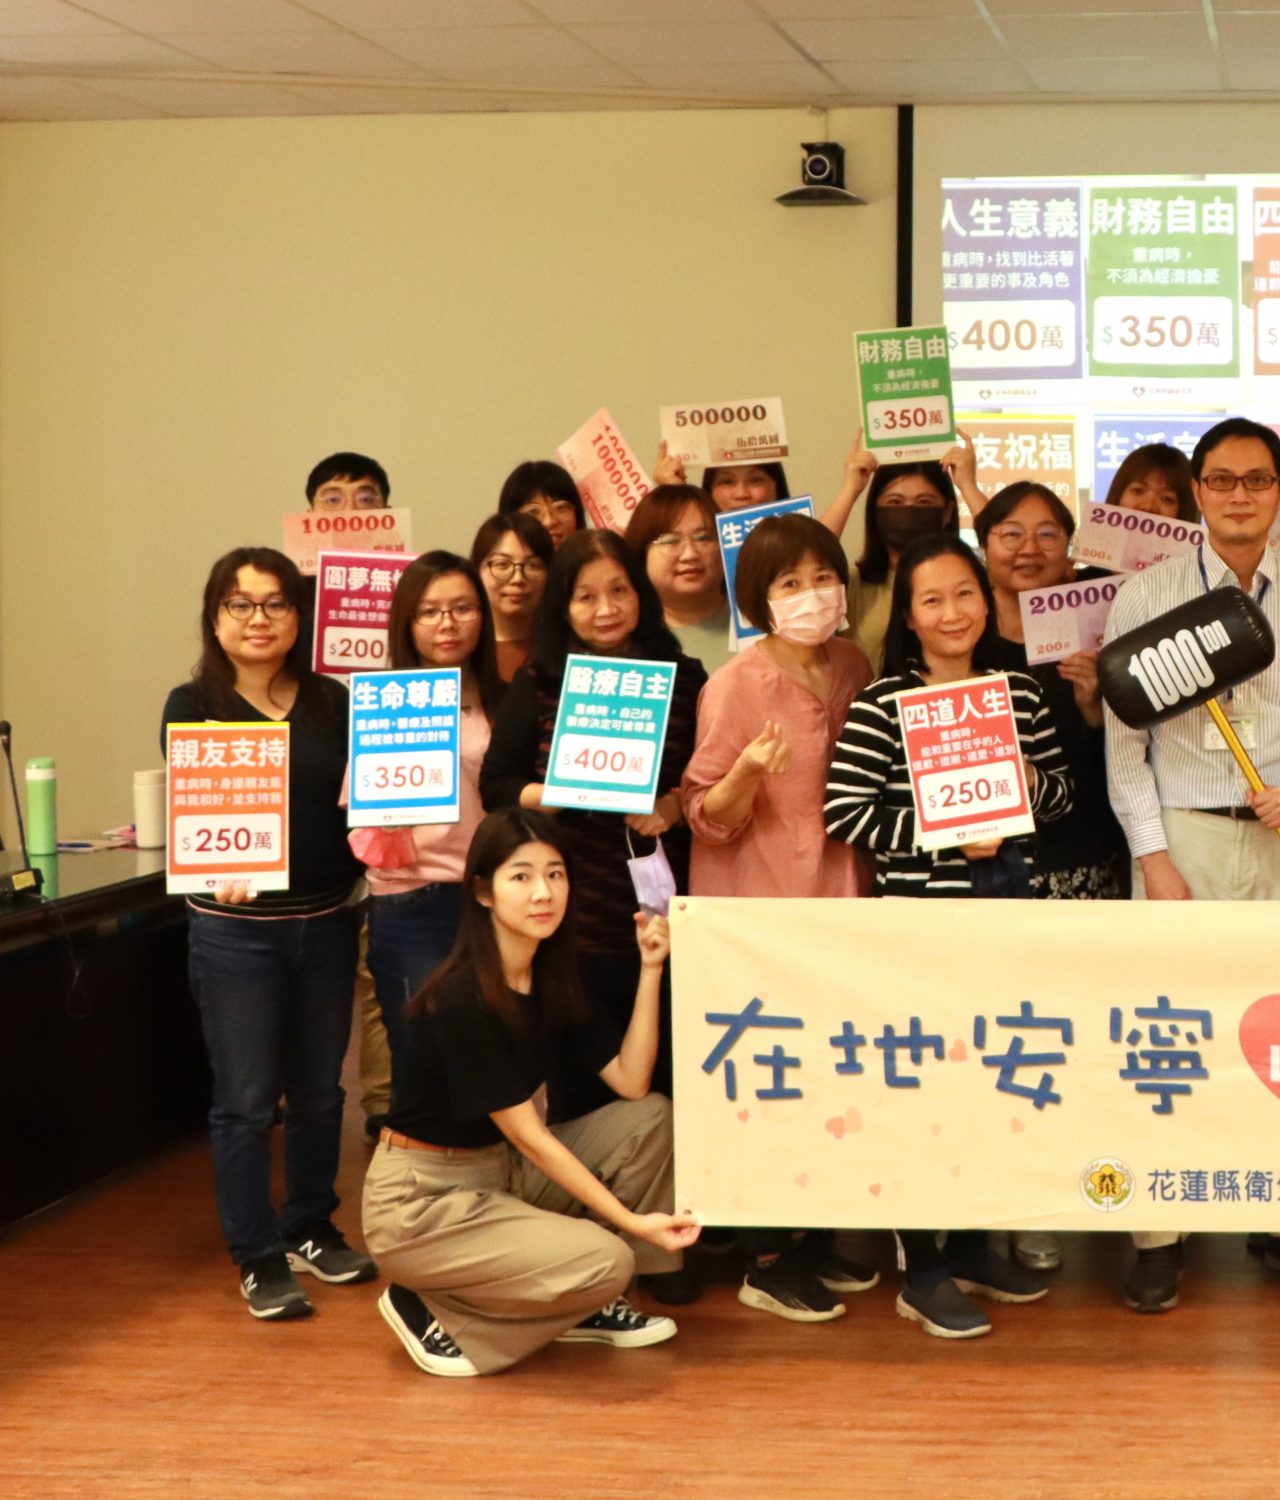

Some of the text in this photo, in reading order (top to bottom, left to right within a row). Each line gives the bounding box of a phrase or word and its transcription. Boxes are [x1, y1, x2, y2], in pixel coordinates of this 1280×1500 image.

[941, 197, 1079, 240] 人生意義
[1091, 195, 1235, 236] 財務自由
[858, 335, 947, 365] 財務自由
[674, 404, 768, 428] 500000
[957, 432, 1073, 470] 友祝福
[590, 432, 638, 511] 100000
[302, 515, 396, 534] 100000
[1090, 508, 1205, 546] 2000000
[1029, 580, 1127, 615] 20000
[567, 666, 670, 701] 醫療自主
[1127, 620, 1232, 713] 1000 ton
[353, 678, 458, 711] 生命尊嚴
[903, 688, 1010, 732] 四道人生
[171, 737, 287, 769] 親友支持
[700, 996, 1214, 1115] 在地安寧
